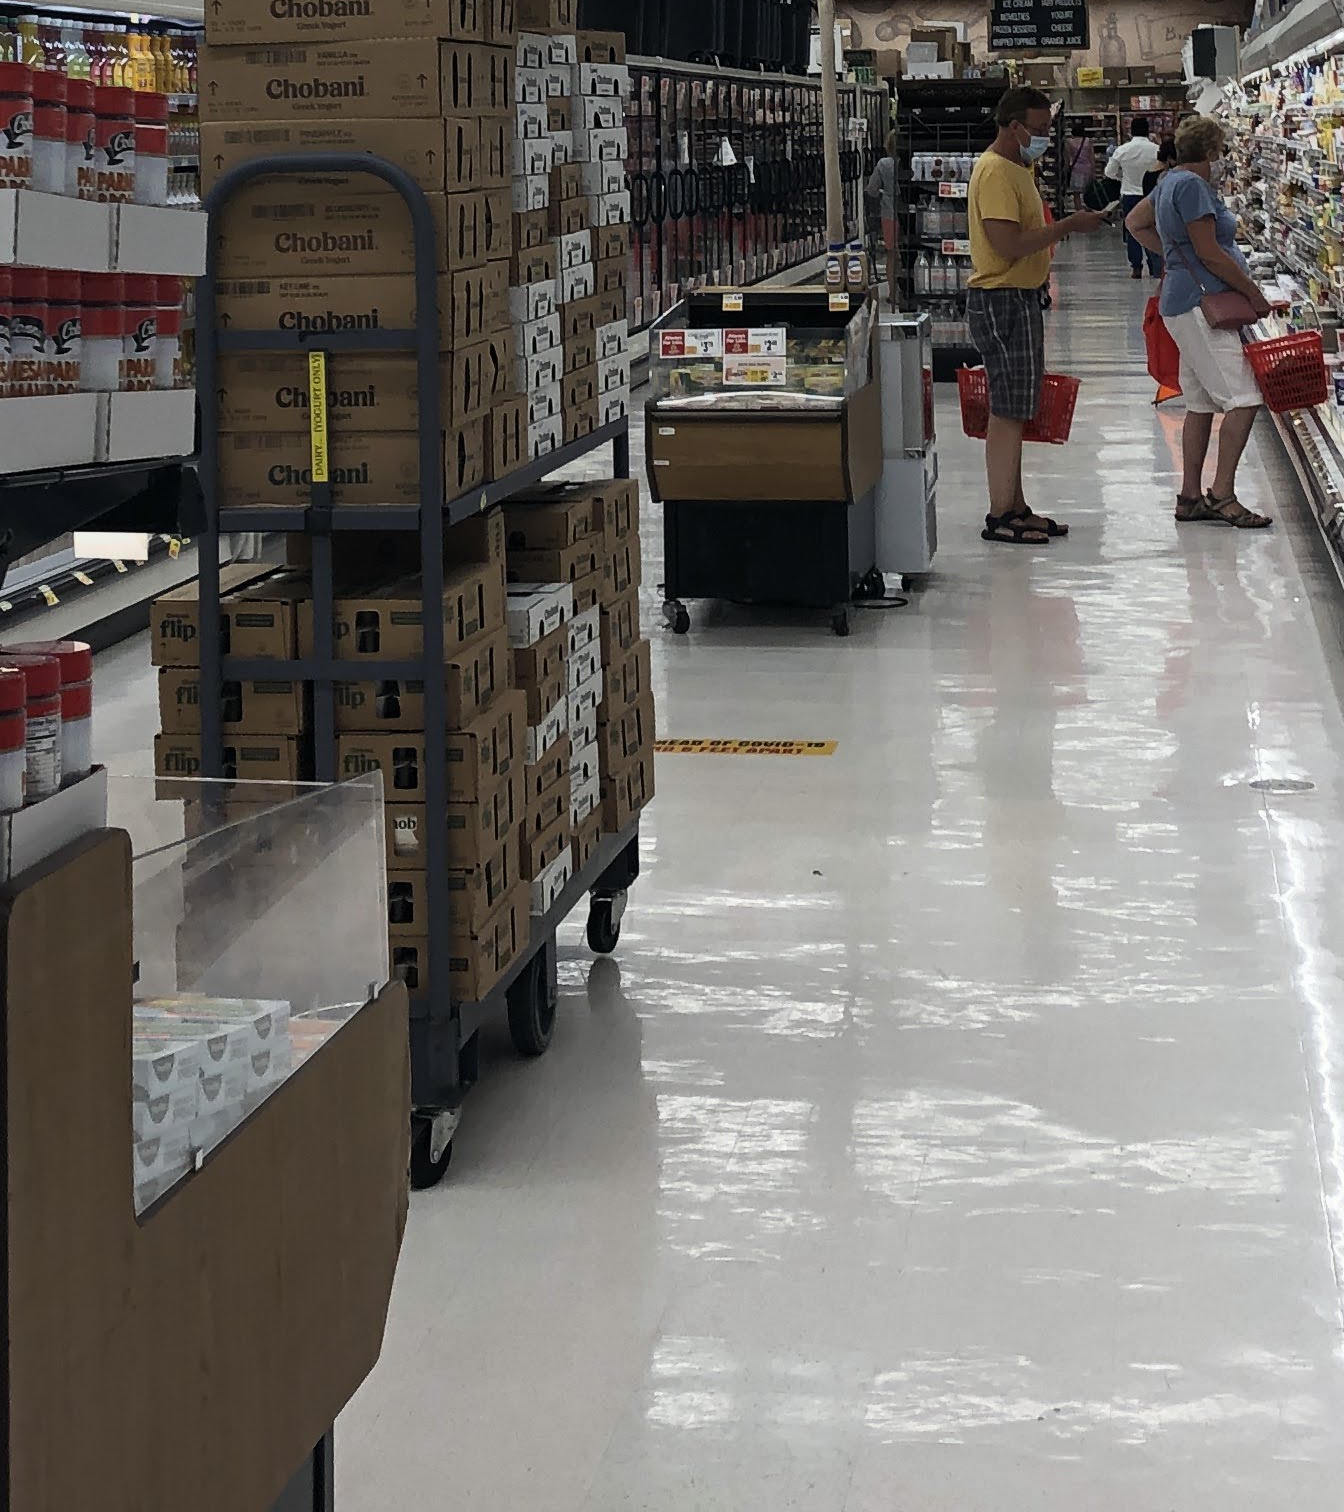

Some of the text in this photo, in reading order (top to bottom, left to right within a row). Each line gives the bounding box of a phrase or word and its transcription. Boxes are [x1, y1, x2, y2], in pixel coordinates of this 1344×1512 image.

[266, 75, 365, 100] Chobani
[274, 229, 374, 254] Chobani
[279, 309, 378, 331] Chobani
[275, 385, 375, 408] Chbani
[268, 462, 368, 486] Choani
[160, 619, 197, 641] flip
[338, 686, 366, 709] lip
[709, 739, 733, 747] OF
[165, 751, 200, 775] flip
[343, 752, 381, 774] flip
